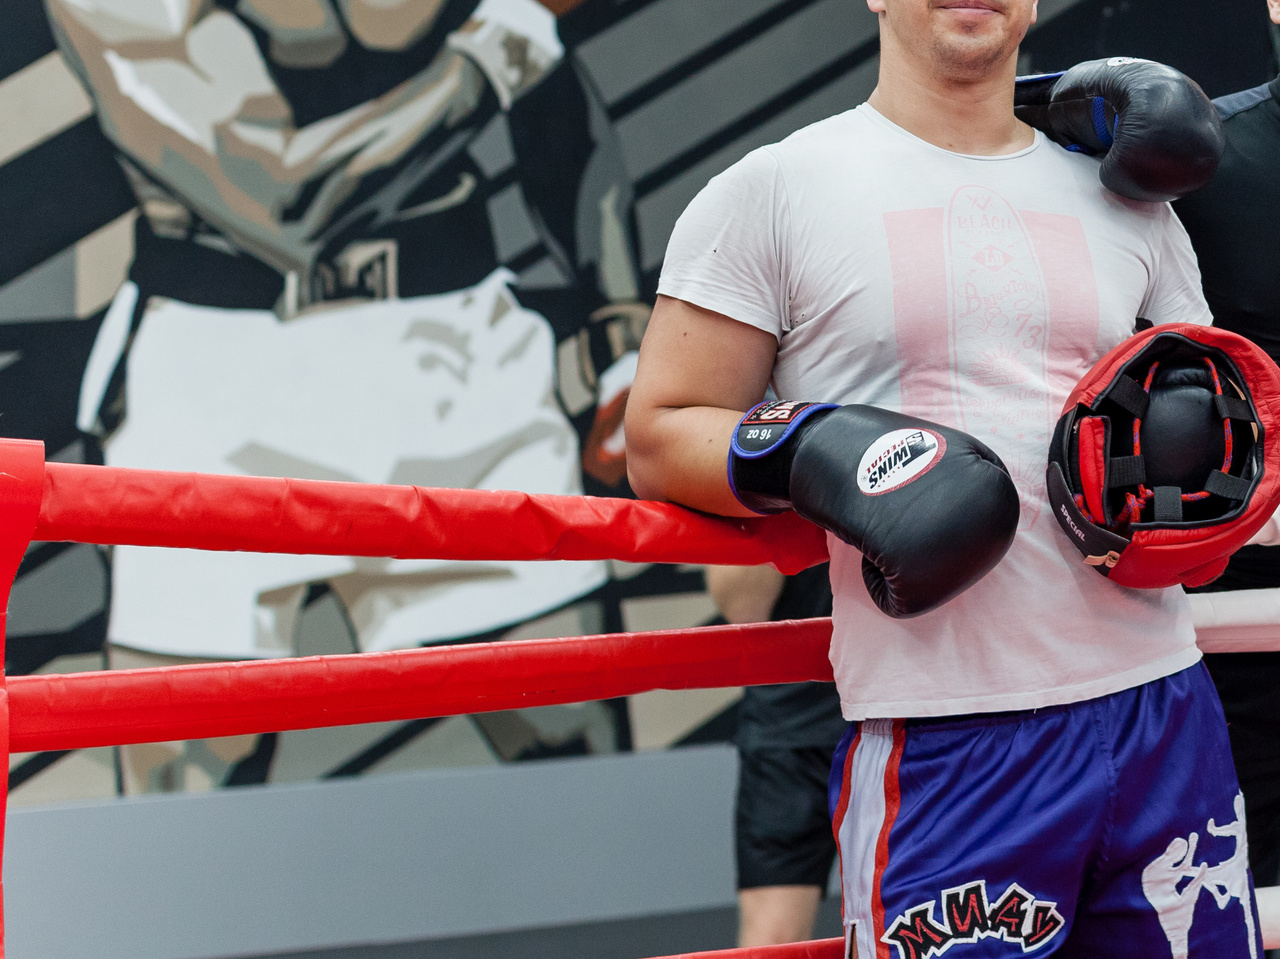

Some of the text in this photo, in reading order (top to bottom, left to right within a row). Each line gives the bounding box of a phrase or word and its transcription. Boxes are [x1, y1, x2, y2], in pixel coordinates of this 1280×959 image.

[759, 428, 772, 440] 16
[868, 431, 937, 490] TWINS
[1060, 503, 1086, 542] SPECIAL
[882, 880, 1065, 959] MUAY
